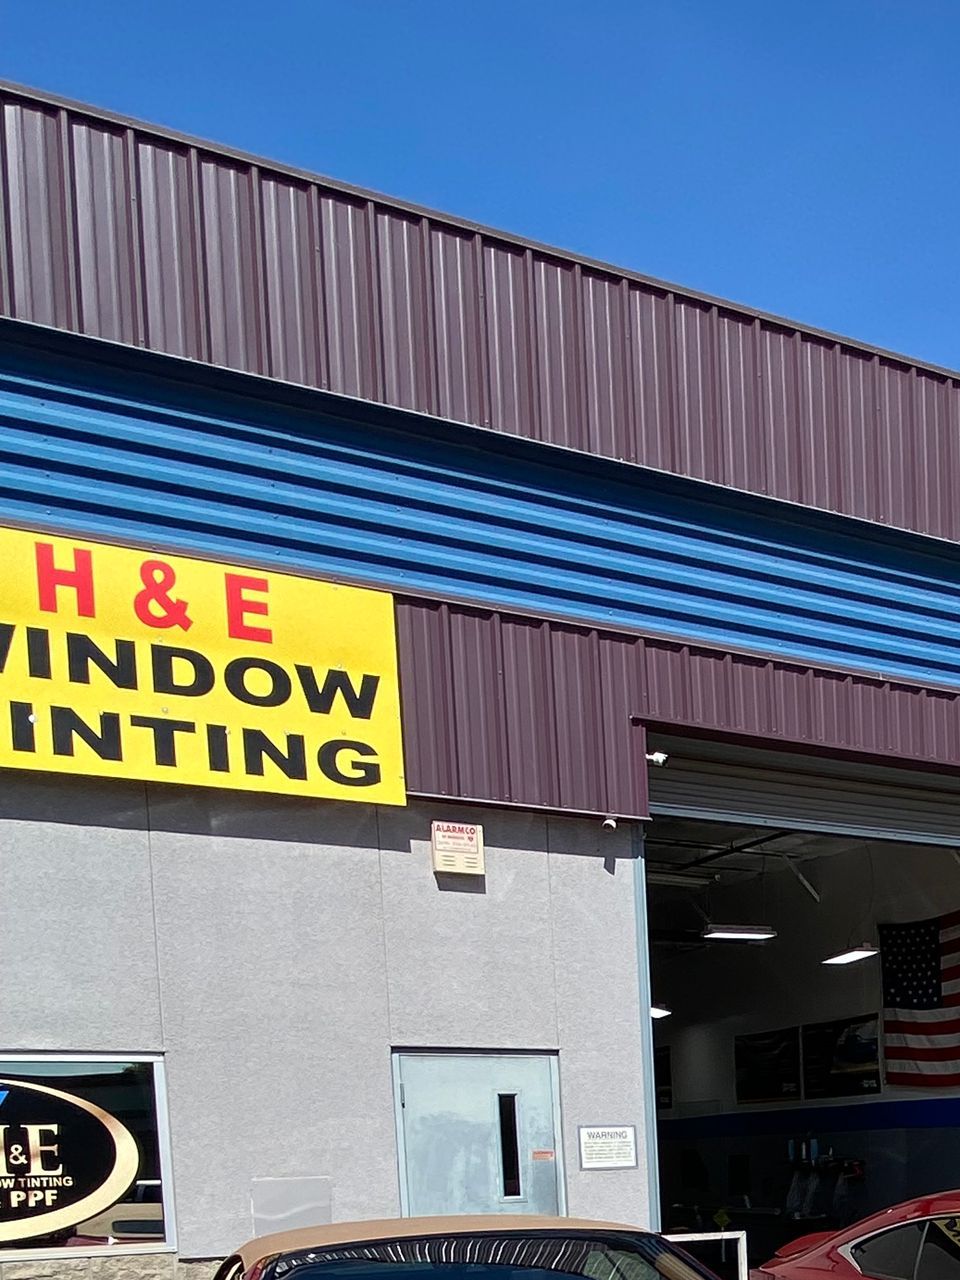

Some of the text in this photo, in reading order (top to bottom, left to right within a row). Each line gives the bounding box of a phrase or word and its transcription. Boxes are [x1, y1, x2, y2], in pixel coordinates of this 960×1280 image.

[35, 542, 273, 643] H & E
[0, 624, 380, 720] INDOW
[10, 701, 382, 787] INTING
[436, 824, 476, 835] ALARMCO
[587, 1131, 628, 1139] WARNING
[17, 1176, 74, 1188] TINTING
[10, 1189, 58, 1208] PPF
